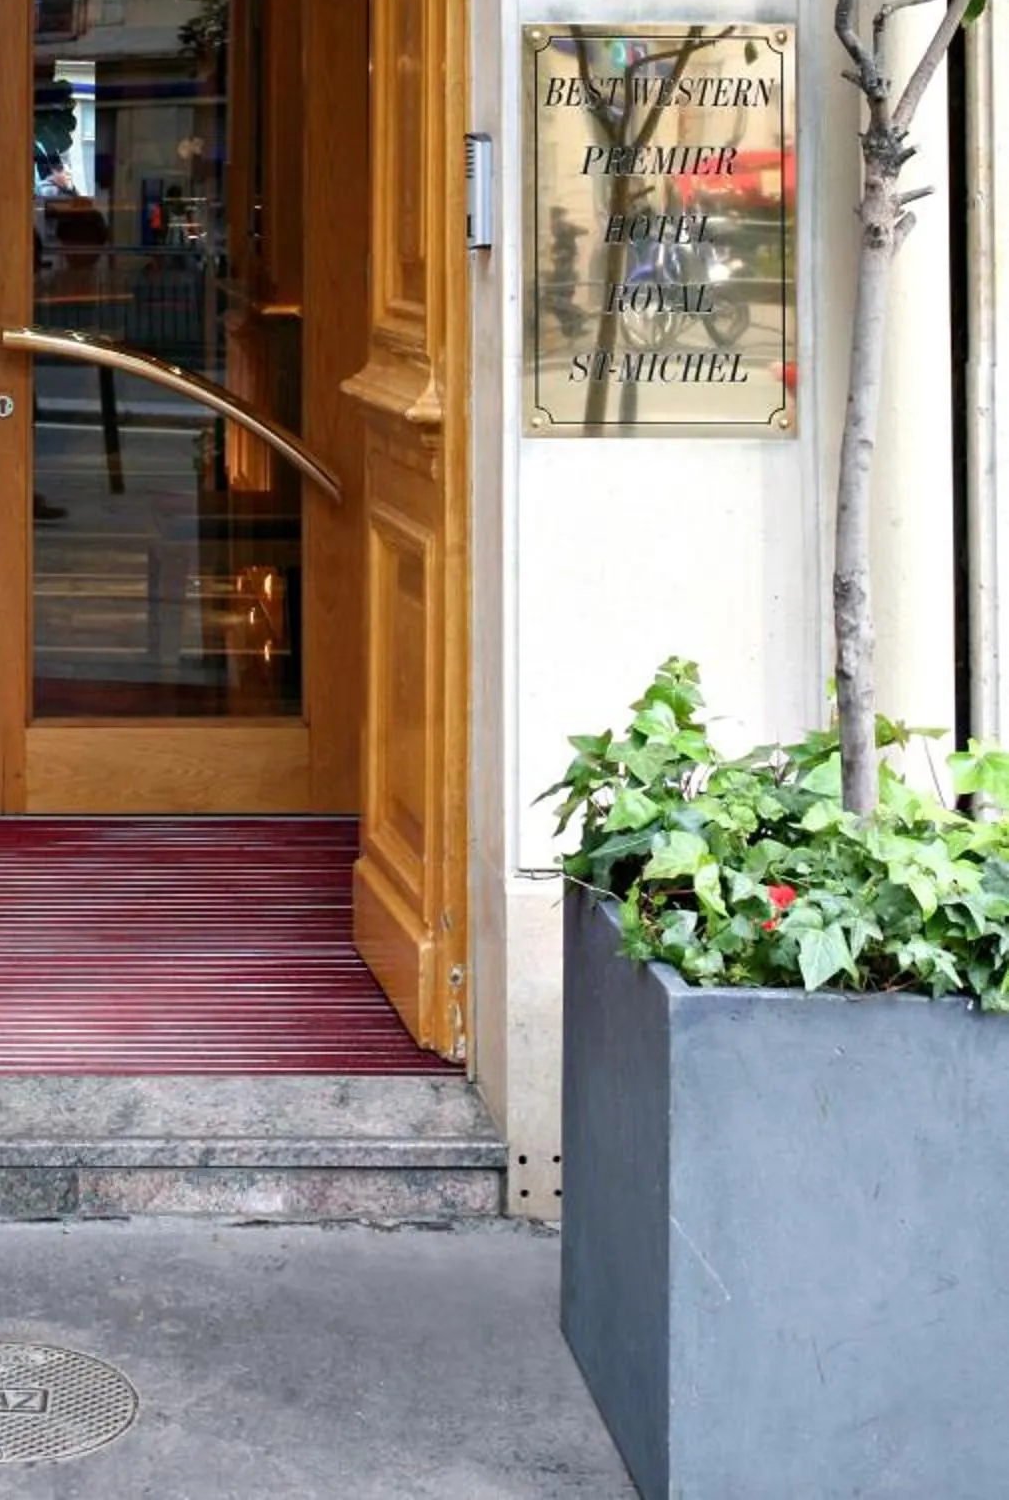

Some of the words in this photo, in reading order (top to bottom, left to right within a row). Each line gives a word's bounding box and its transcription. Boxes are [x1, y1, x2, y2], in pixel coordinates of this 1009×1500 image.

[544, 77, 623, 107] BEST
[631, 77, 775, 107] WESTERN
[579, 146, 738, 175] PREMIER
[604, 215, 714, 243] HOTEL
[605, 283, 714, 313] ROYAL
[568, 353, 749, 383] ST-MICHEL
